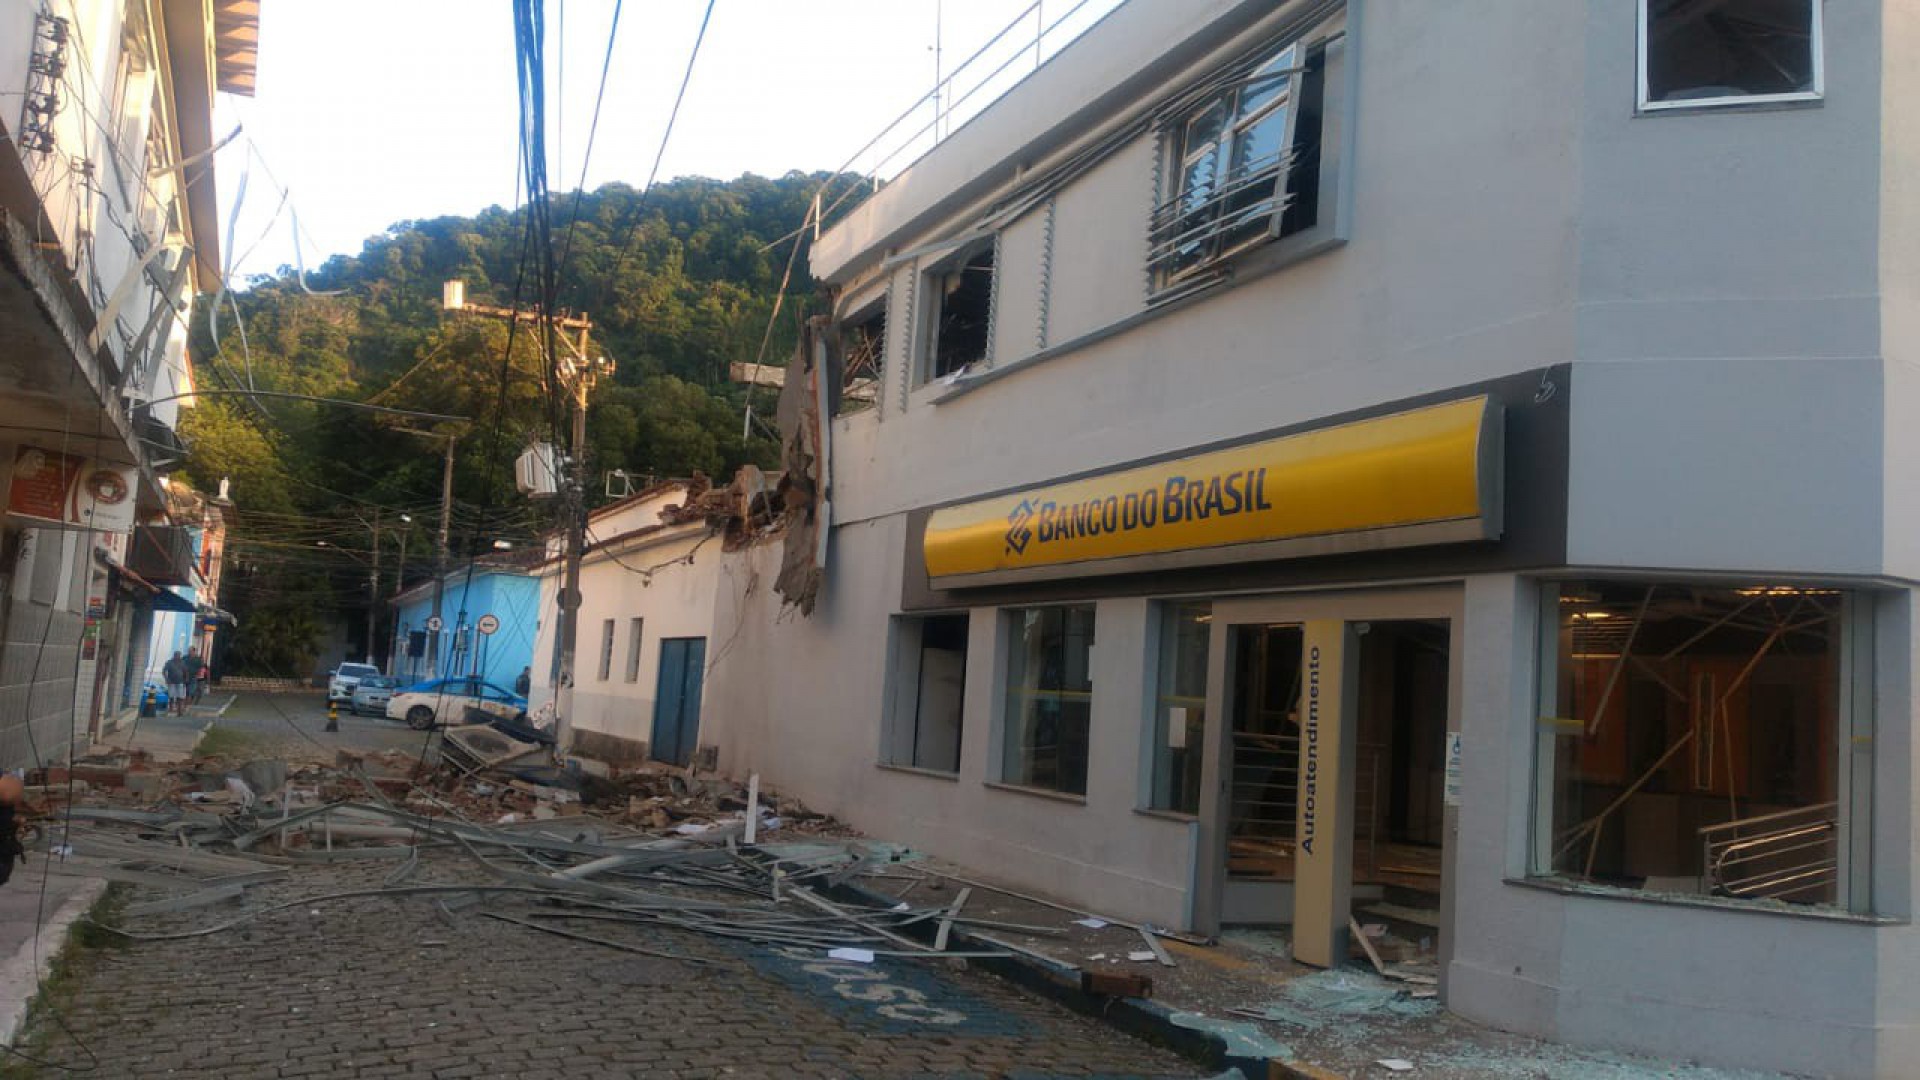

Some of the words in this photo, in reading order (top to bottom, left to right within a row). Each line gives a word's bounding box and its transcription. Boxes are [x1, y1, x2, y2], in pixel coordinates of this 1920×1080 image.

[1038, 495, 1118, 543] BANCO
[1123, 488, 1159, 531] DO
[1163, 467, 1272, 525] BRASIL
[1302, 647, 1320, 855] Autoatendimento
